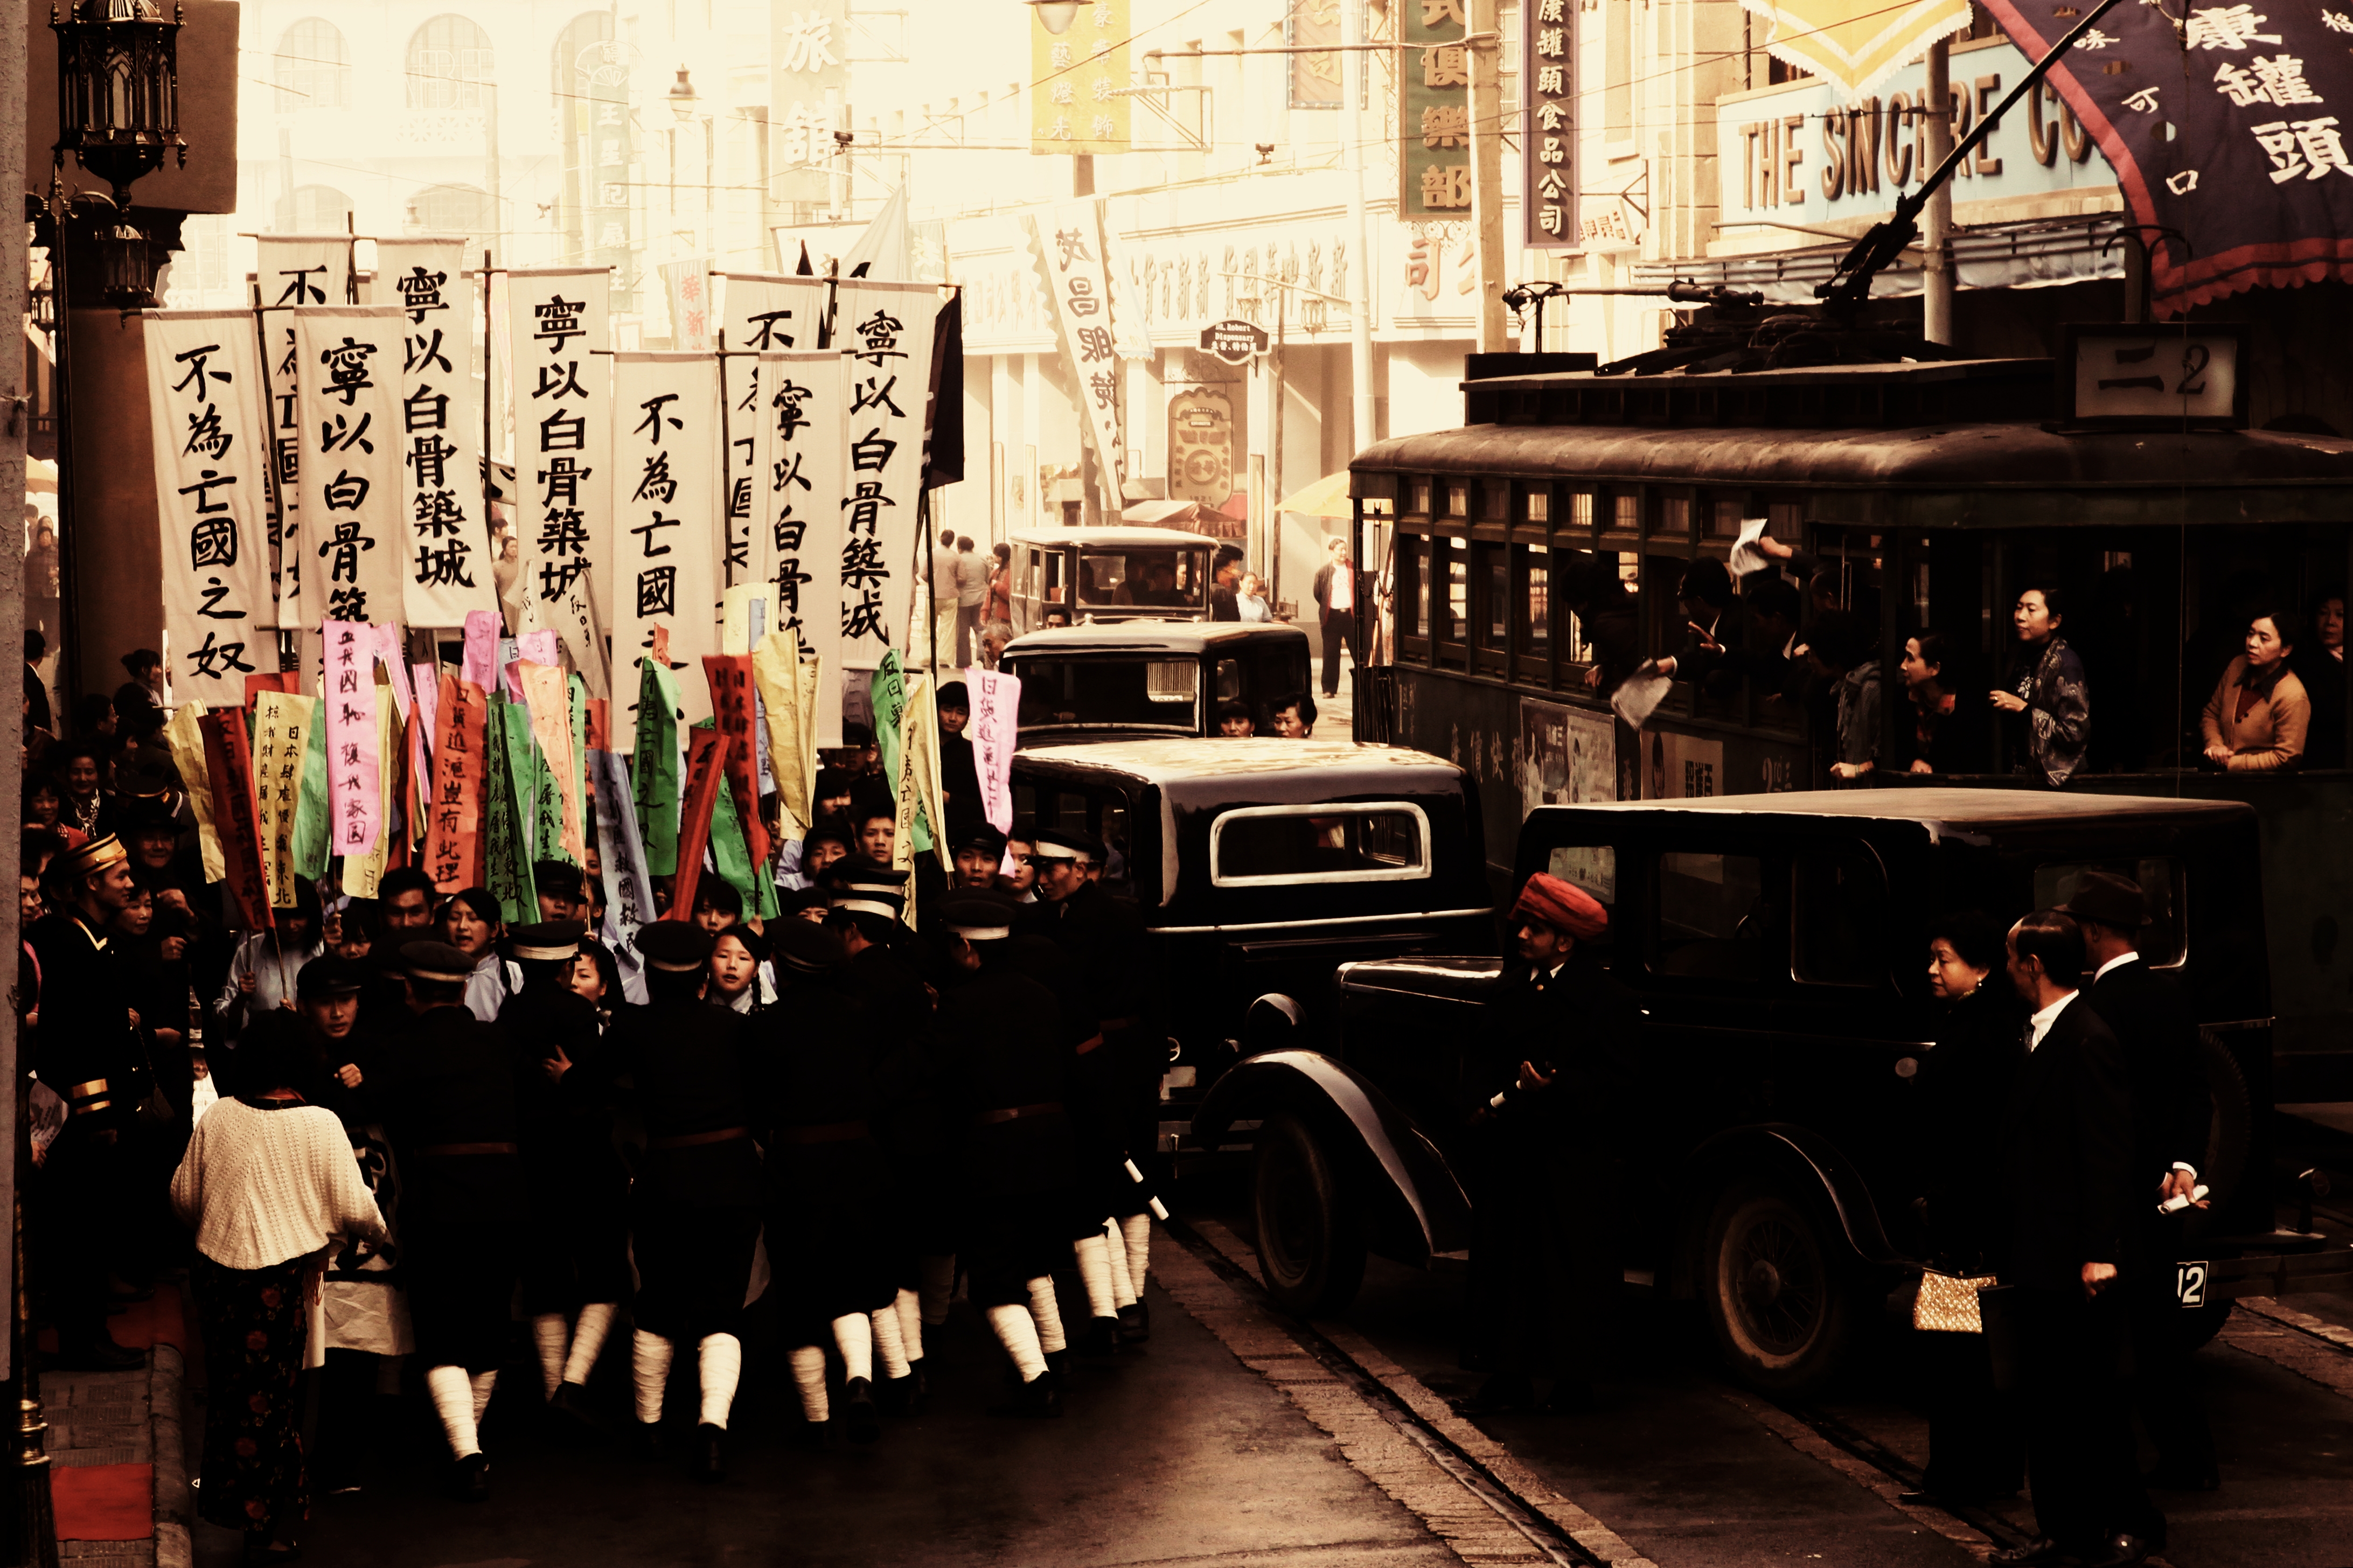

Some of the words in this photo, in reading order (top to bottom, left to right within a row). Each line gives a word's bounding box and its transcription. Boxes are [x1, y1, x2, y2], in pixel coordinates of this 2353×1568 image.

[1738, 113, 1804, 209] THE
[398, 267, 476, 588] 寧以白骨築城
[681, 275, 706, 350] 華新
[2176, 344, 2210, 395] 2
[172, 344, 256, 679] 不為亡國之奴
[318, 337, 377, 626] 寧以白骨築
[771, 379, 815, 663] 寧以白骨
